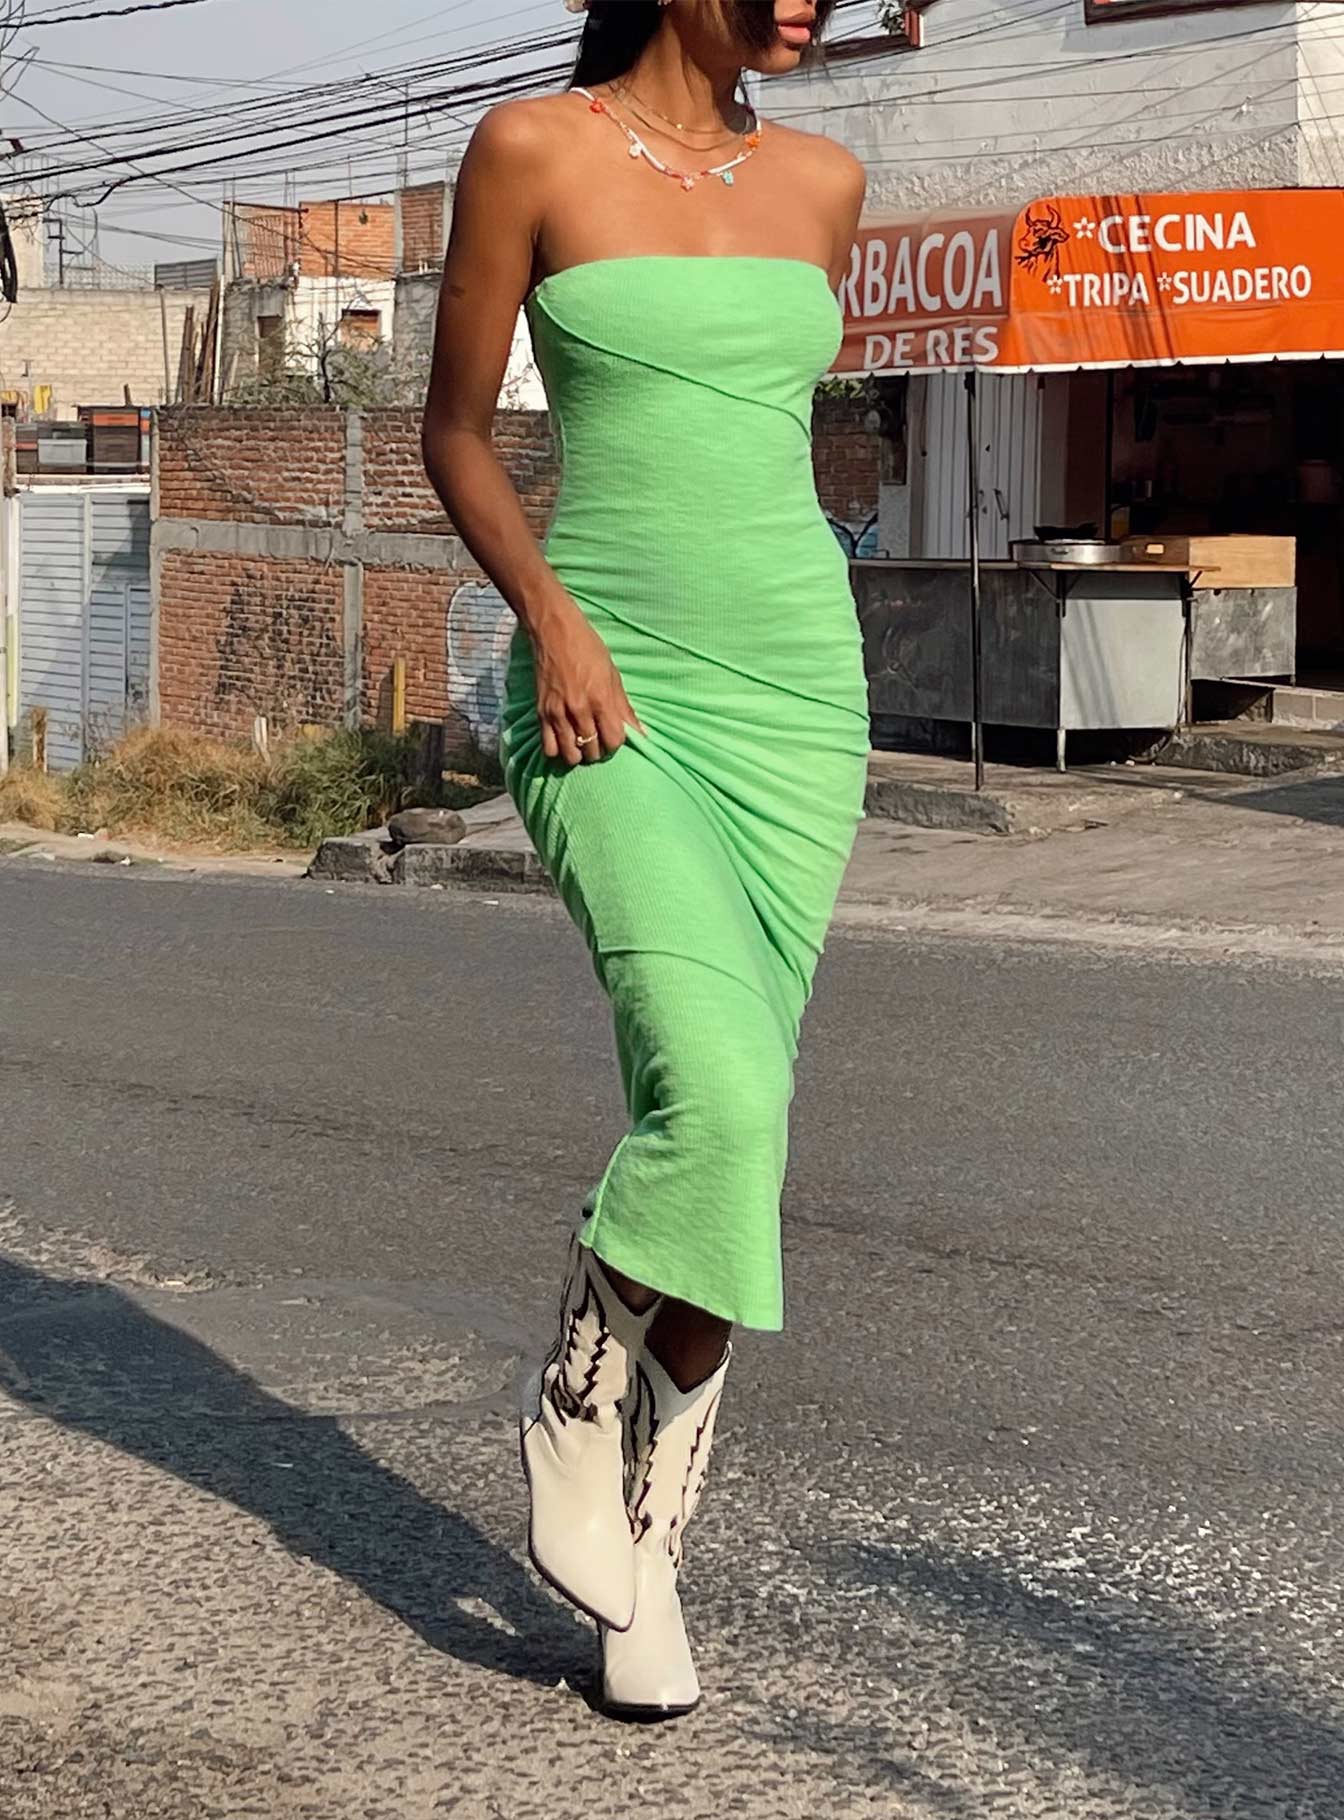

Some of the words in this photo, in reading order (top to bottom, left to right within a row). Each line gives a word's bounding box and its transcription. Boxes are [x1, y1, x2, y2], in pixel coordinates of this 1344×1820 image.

[1099, 212, 1256, 253] CECINA
[1064, 272, 1150, 307] TRIPA
[1173, 265, 1312, 304] SUADERO
[864, 332, 915, 370] DE
[926, 326, 999, 365] RES
